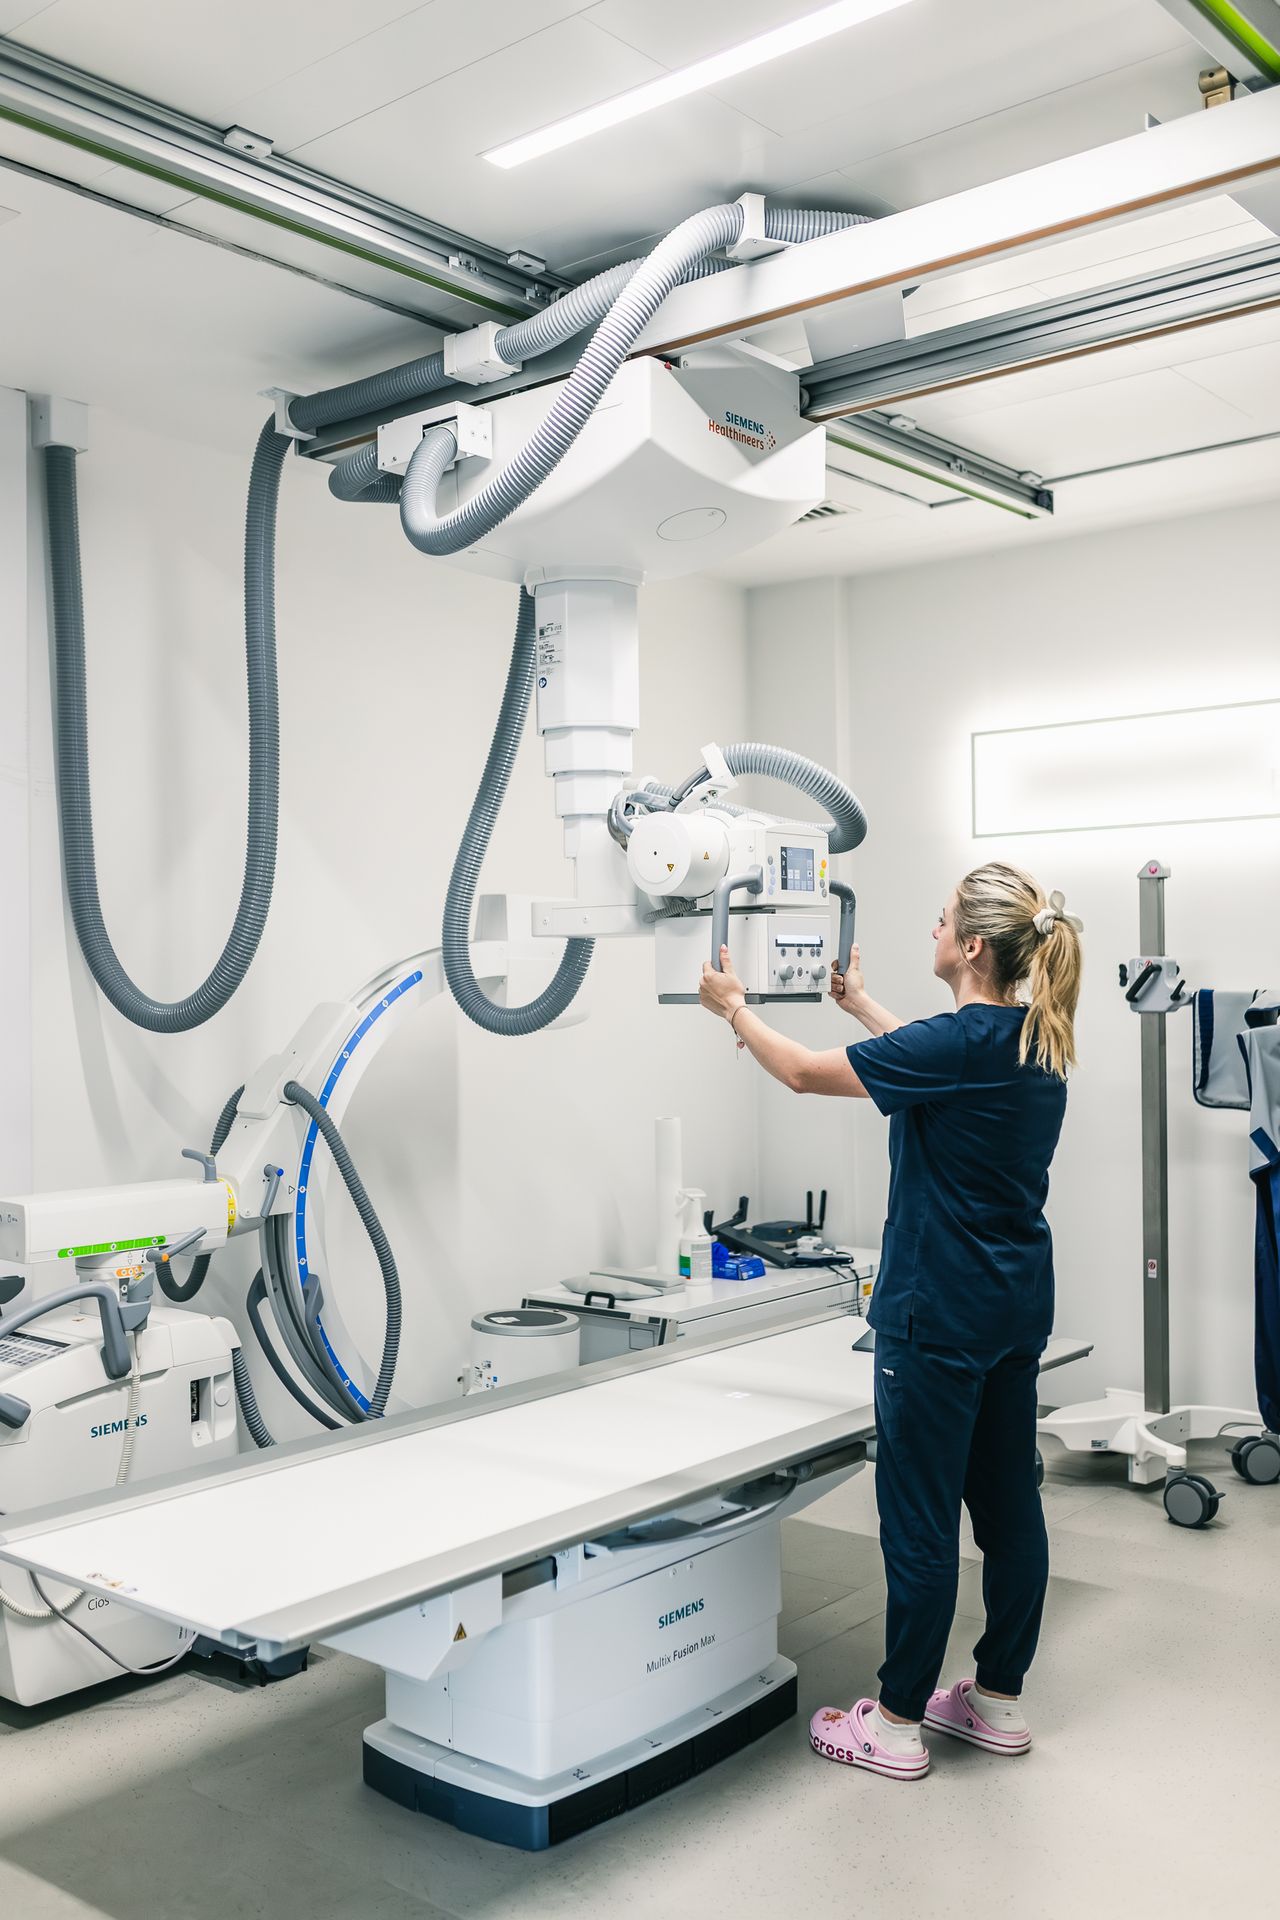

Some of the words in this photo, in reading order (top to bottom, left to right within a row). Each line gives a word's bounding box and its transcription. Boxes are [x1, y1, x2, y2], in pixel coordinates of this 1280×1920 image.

[708, 419, 765, 450] Healthineers
[725, 411, 765, 435] SIEMENS
[88, 1597, 110, 1611] Cios
[658, 1598, 704, 1629] SIEMENS
[646, 1654, 671, 1674] Multix
[673, 1642, 699, 1661] Fusion
[700, 1634, 716, 1648] Max
[813, 1736, 854, 1762] crocs
